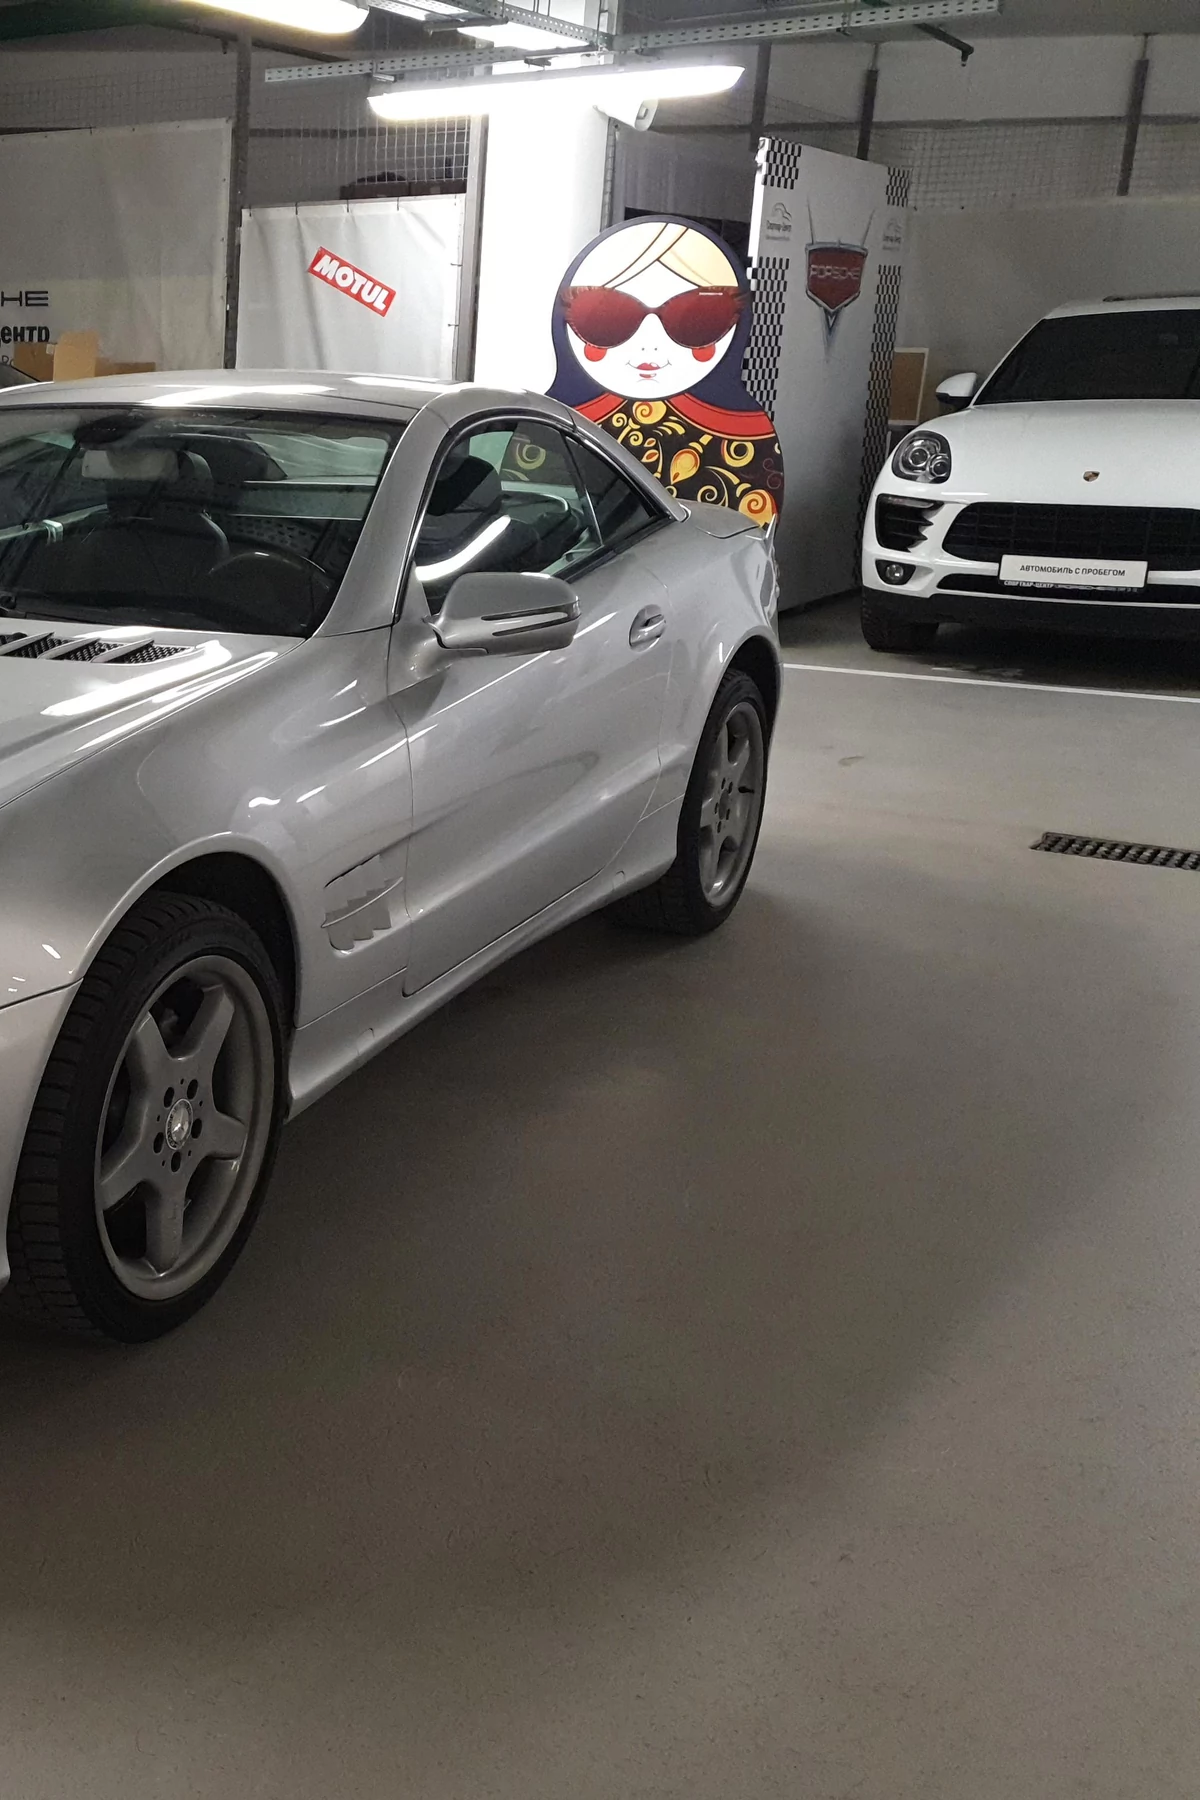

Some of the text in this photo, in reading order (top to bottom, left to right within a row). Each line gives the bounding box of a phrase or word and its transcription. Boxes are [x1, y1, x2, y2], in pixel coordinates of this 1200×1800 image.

[312, 253, 390, 312] MOTUL
[1019, 564, 1073, 575] АВТОМОБИЛЬ
[1081, 568, 1126, 577] ПРОБЕГОМ
